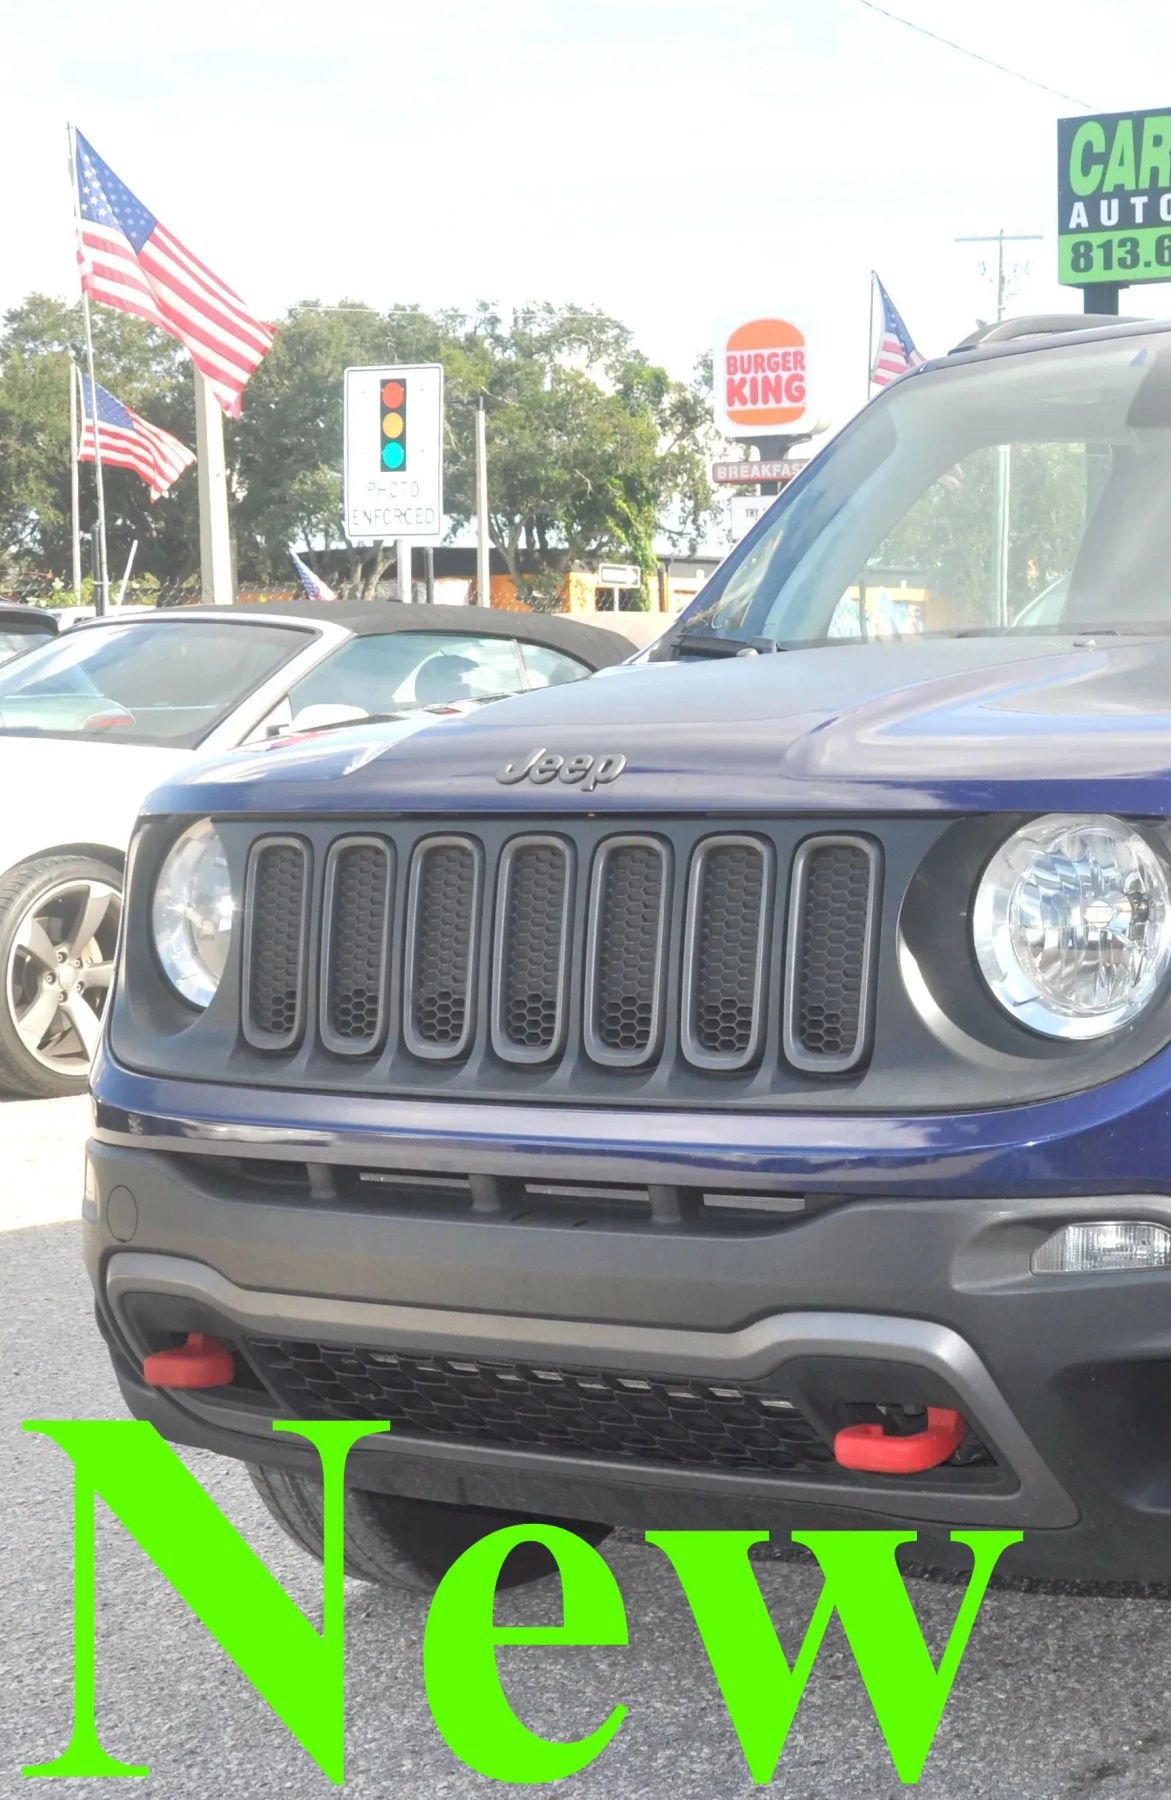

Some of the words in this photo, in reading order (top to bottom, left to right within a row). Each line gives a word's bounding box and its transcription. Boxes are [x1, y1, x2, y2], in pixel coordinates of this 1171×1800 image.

[726, 350, 806, 375] BURGER
[726, 373, 806, 407] KING
[717, 462, 804, 479] BREAKFAS
[367, 480, 420, 498] PHOTO
[352, 507, 435, 526] ENFORCED
[496, 748, 626, 792] Jeep
